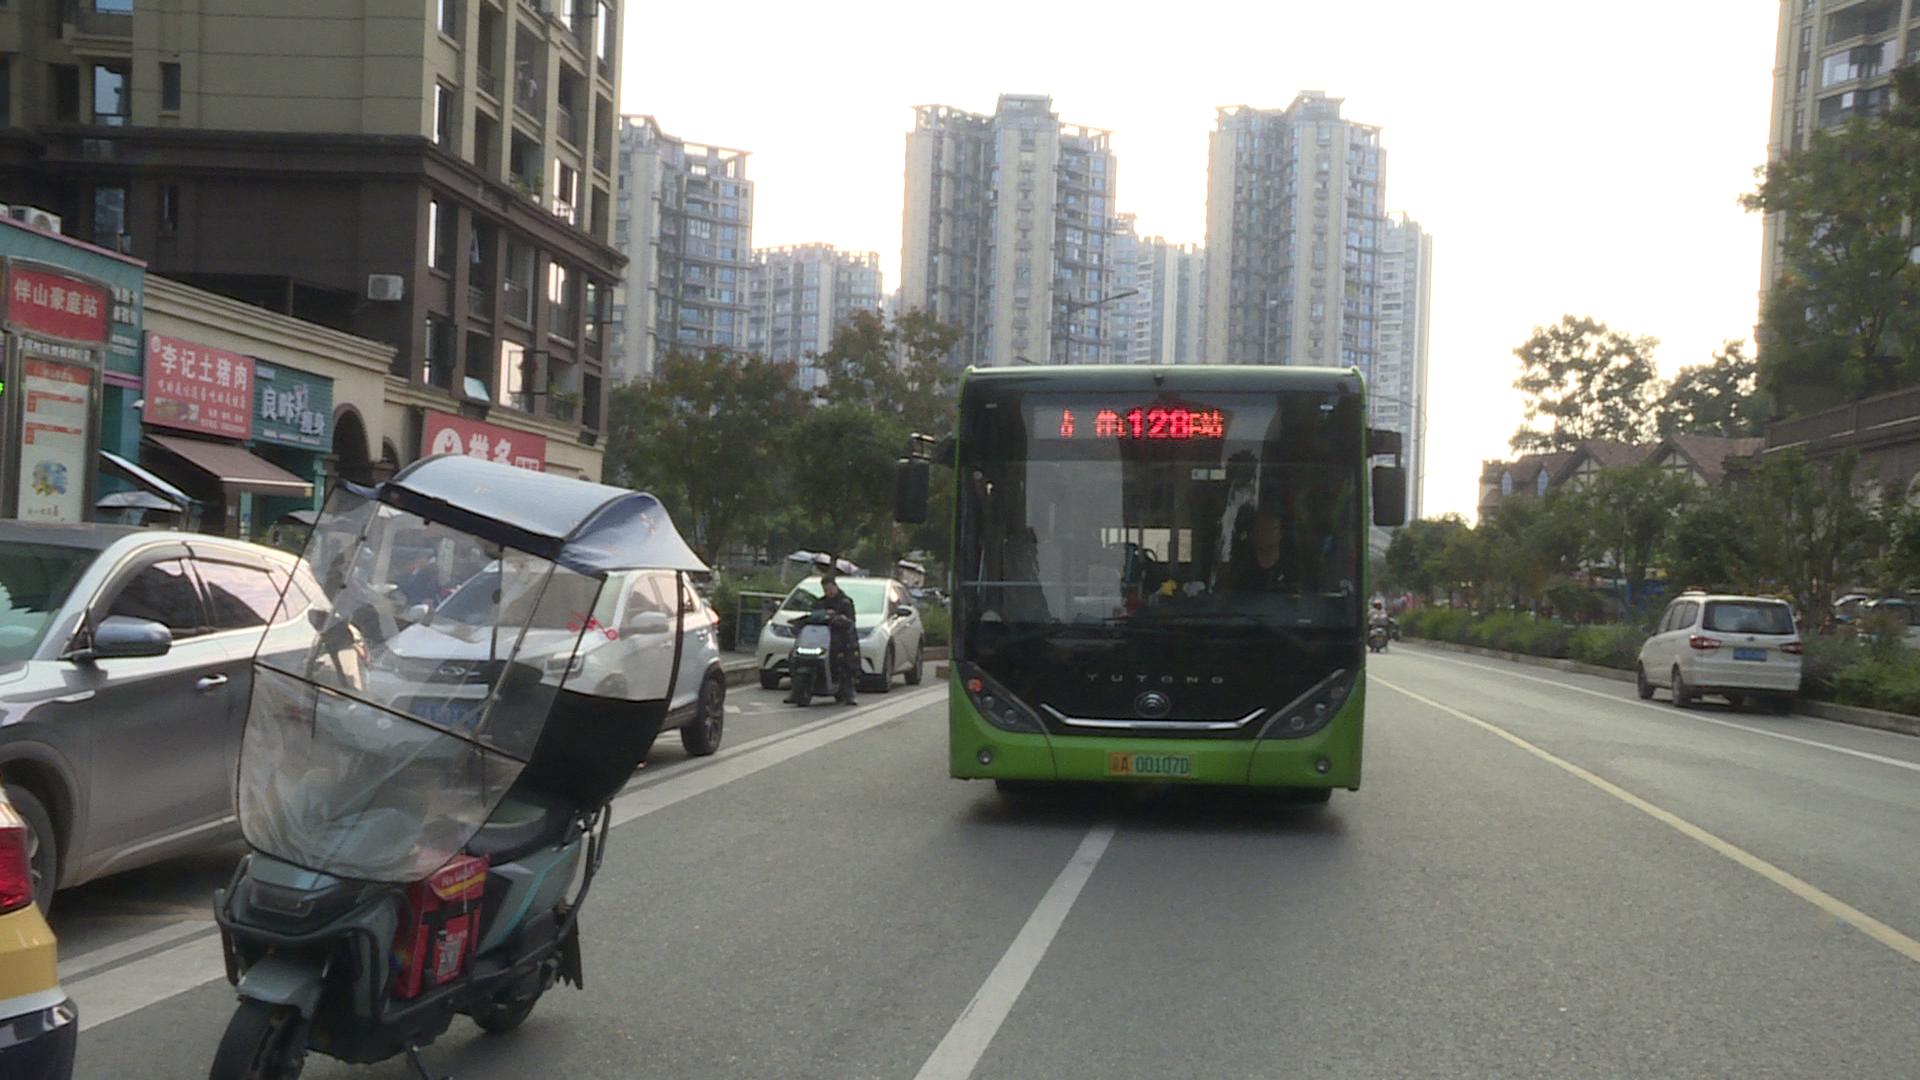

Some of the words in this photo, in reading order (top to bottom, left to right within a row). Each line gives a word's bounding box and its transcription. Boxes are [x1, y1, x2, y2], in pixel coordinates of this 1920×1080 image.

[160, 343, 248, 392] 李记土猪肉
[1087, 673, 1224, 684] YUTONG
